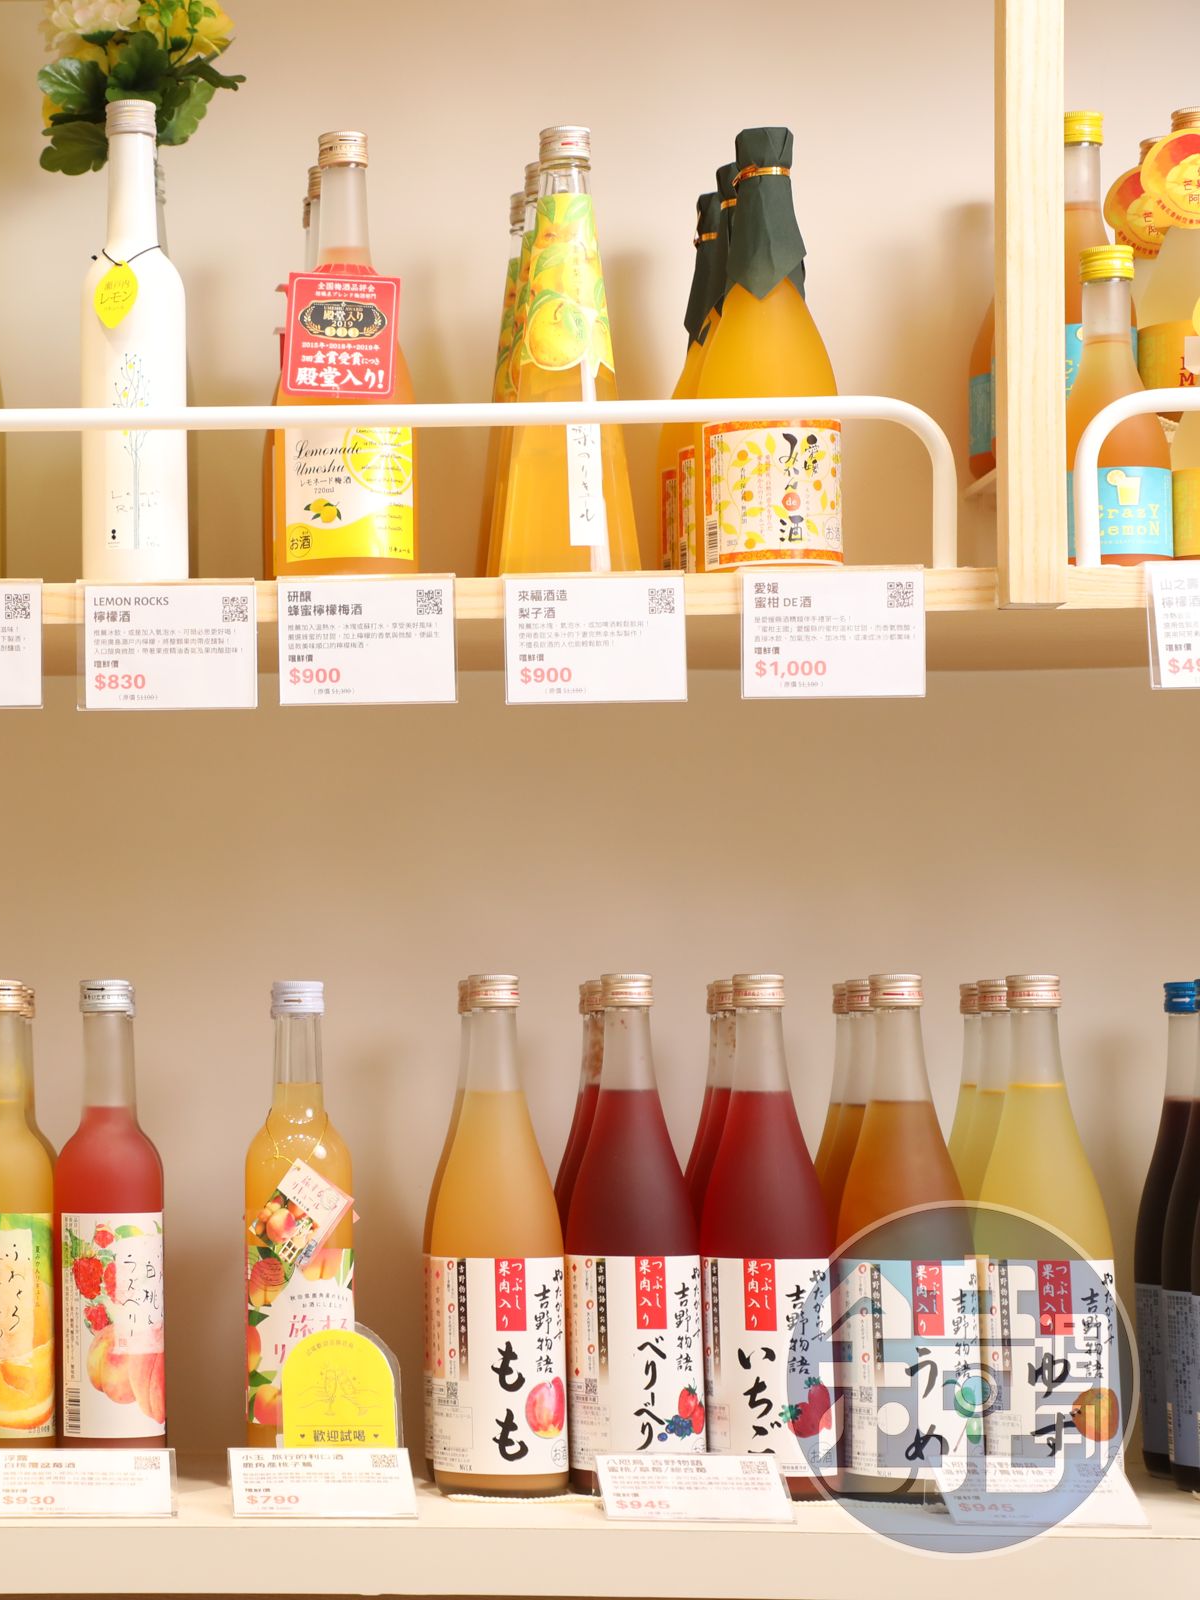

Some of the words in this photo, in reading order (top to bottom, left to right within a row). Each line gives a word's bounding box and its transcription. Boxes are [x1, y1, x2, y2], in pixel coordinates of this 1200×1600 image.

[317, 281, 376, 293] 全国梅酒品評会
[100, 291, 132, 305] レモン
[323, 311, 364, 322] 殿堂入り
[295, 439, 362, 460] Lemonade
[300, 476, 352, 487] レモネード梅酒
[314, 487, 335, 495] 720ml
[1098, 519, 1161, 538] emoN
[289, 534, 311, 551] お酒
[288, 590, 312, 603] 研釀
[518, 589, 568, 602] 來福酒造
[754, 582, 779, 595] 愛媛
[93, 597, 131, 606] LEMON
[134, 596, 169, 606] ROCKS
[288, 603, 363, 617] 蜂蜜檸檬梅酒
[754, 596, 780, 609] 蜜柑
[783, 597, 798, 608] DE
[799, 595, 812, 608] 酒
[93, 610, 131, 623] 檸檬酒
[518, 606, 556, 619] 梨子酒
[289, 667, 341, 685] $900
[520, 666, 572, 685] $900
[755, 659, 827, 678] $1,000
[94, 673, 146, 691] $830
[511, 1262, 524, 1312] つぶし
[638, 1259, 652, 1327] 果肉入り
[651, 1260, 663, 1309] つぶし
[747, 1260, 761, 1328] 果肉入り
[760, 1261, 773, 1310] つぶし
[928, 1266, 940, 1315] つぶし
[1055, 1264, 1070, 1314] つぶし
[121, 1254, 140, 1338] ラズベリー
[498, 1261, 512, 1329] 果肉入り
[915, 1265, 929, 1333] 果肉入り
[1041, 1264, 1056, 1332] 果肉入り
[533, 1284, 554, 1374] 吉野物語
[673, 1282, 694, 1372] 吉野物語
[785, 1284, 811, 1375] 吉野物語
[951, 1288, 971, 1379] 吉野物語
[1080, 1287, 1105, 1379] 吉野物語
[491, 1340, 529, 1462] もも
[737, 1346, 782, 1454] いちご
[905, 1346, 950, 1461] うめ
[1027, 1352, 1082, 1458] ゆず
[313, 1429, 366, 1443] 歡迎試喝
[651, 1459, 703, 1467] 吉野物語
[2, 1495, 56, 1505] $930
[246, 1495, 300, 1505] $790
[615, 1500, 671, 1510] $945
[958, 1502, 1016, 1514] $945
